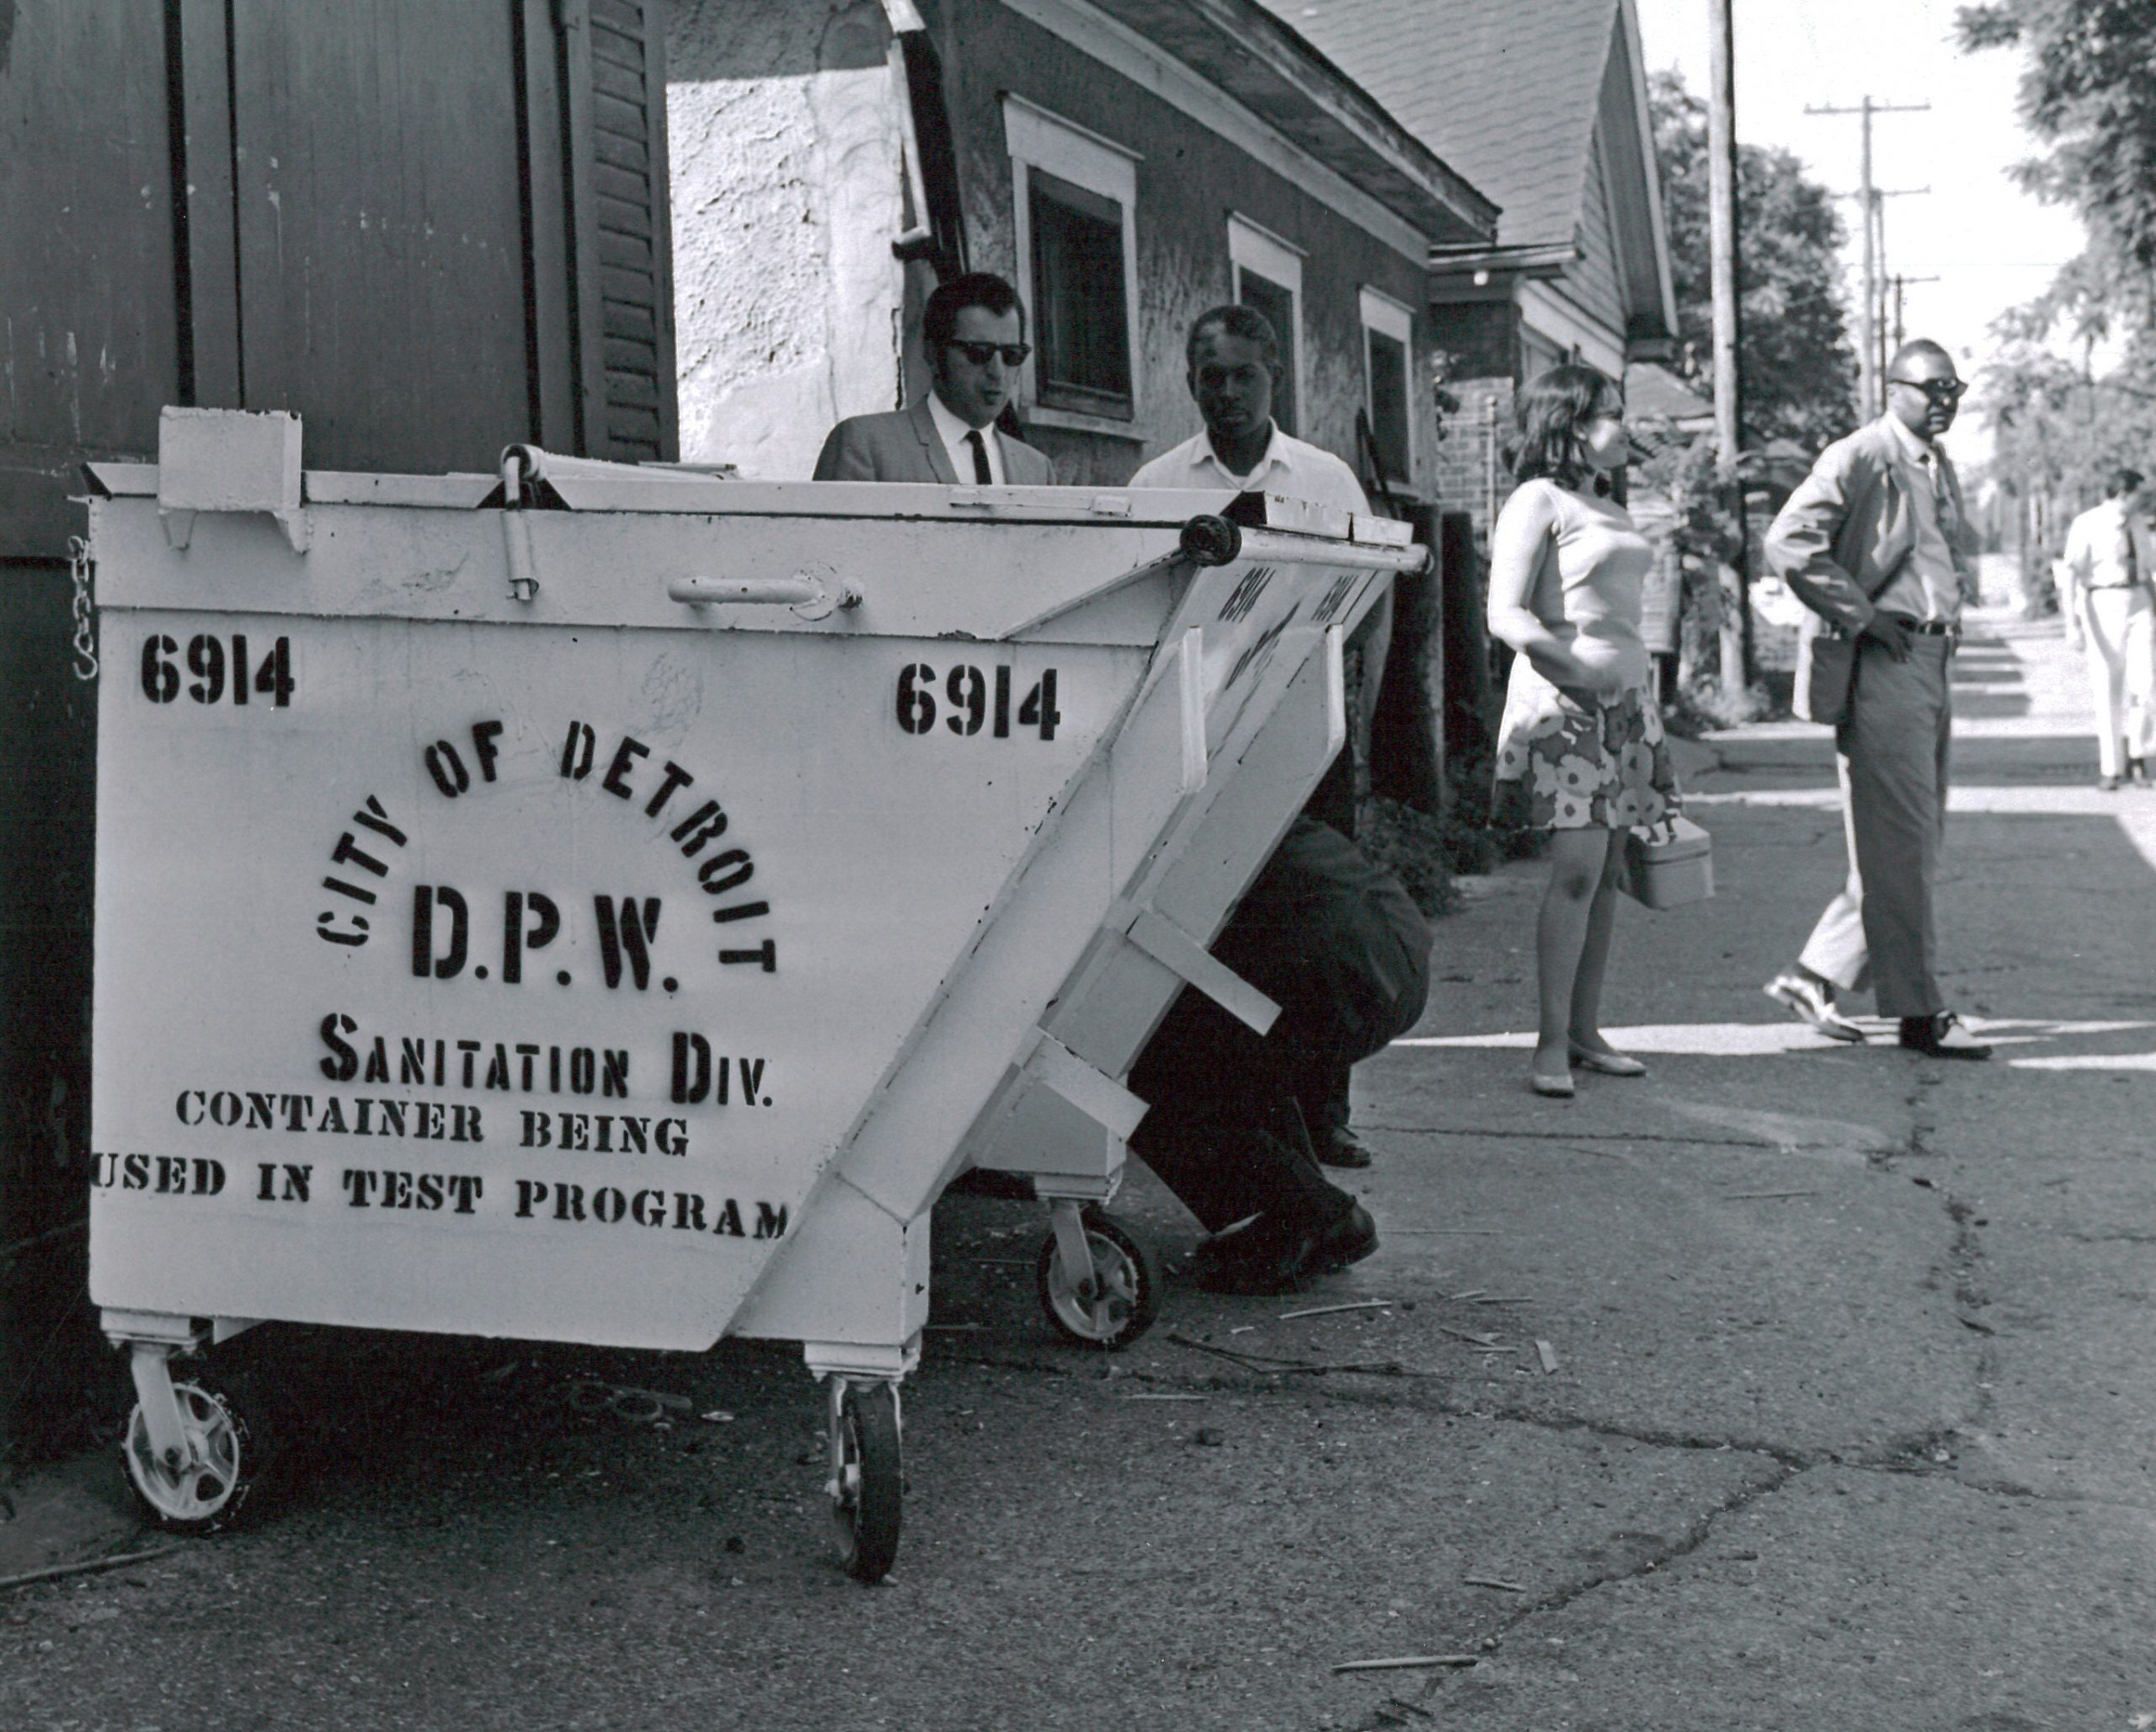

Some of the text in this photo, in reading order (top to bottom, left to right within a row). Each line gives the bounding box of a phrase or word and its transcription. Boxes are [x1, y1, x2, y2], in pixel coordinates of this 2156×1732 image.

[141, 634, 295, 707] 6914
[896, 663, 1060, 740] 6914
[317, 720, 776, 973] CITY OF DETROIT
[413, 885, 679, 994] D.P.W.
[319, 1013, 774, 1107] SANITATION DIV.
[176, 1090, 690, 1157] CONTAINER BEING
[90, 1152, 788, 1240] USED IN TEST PROGRAM
